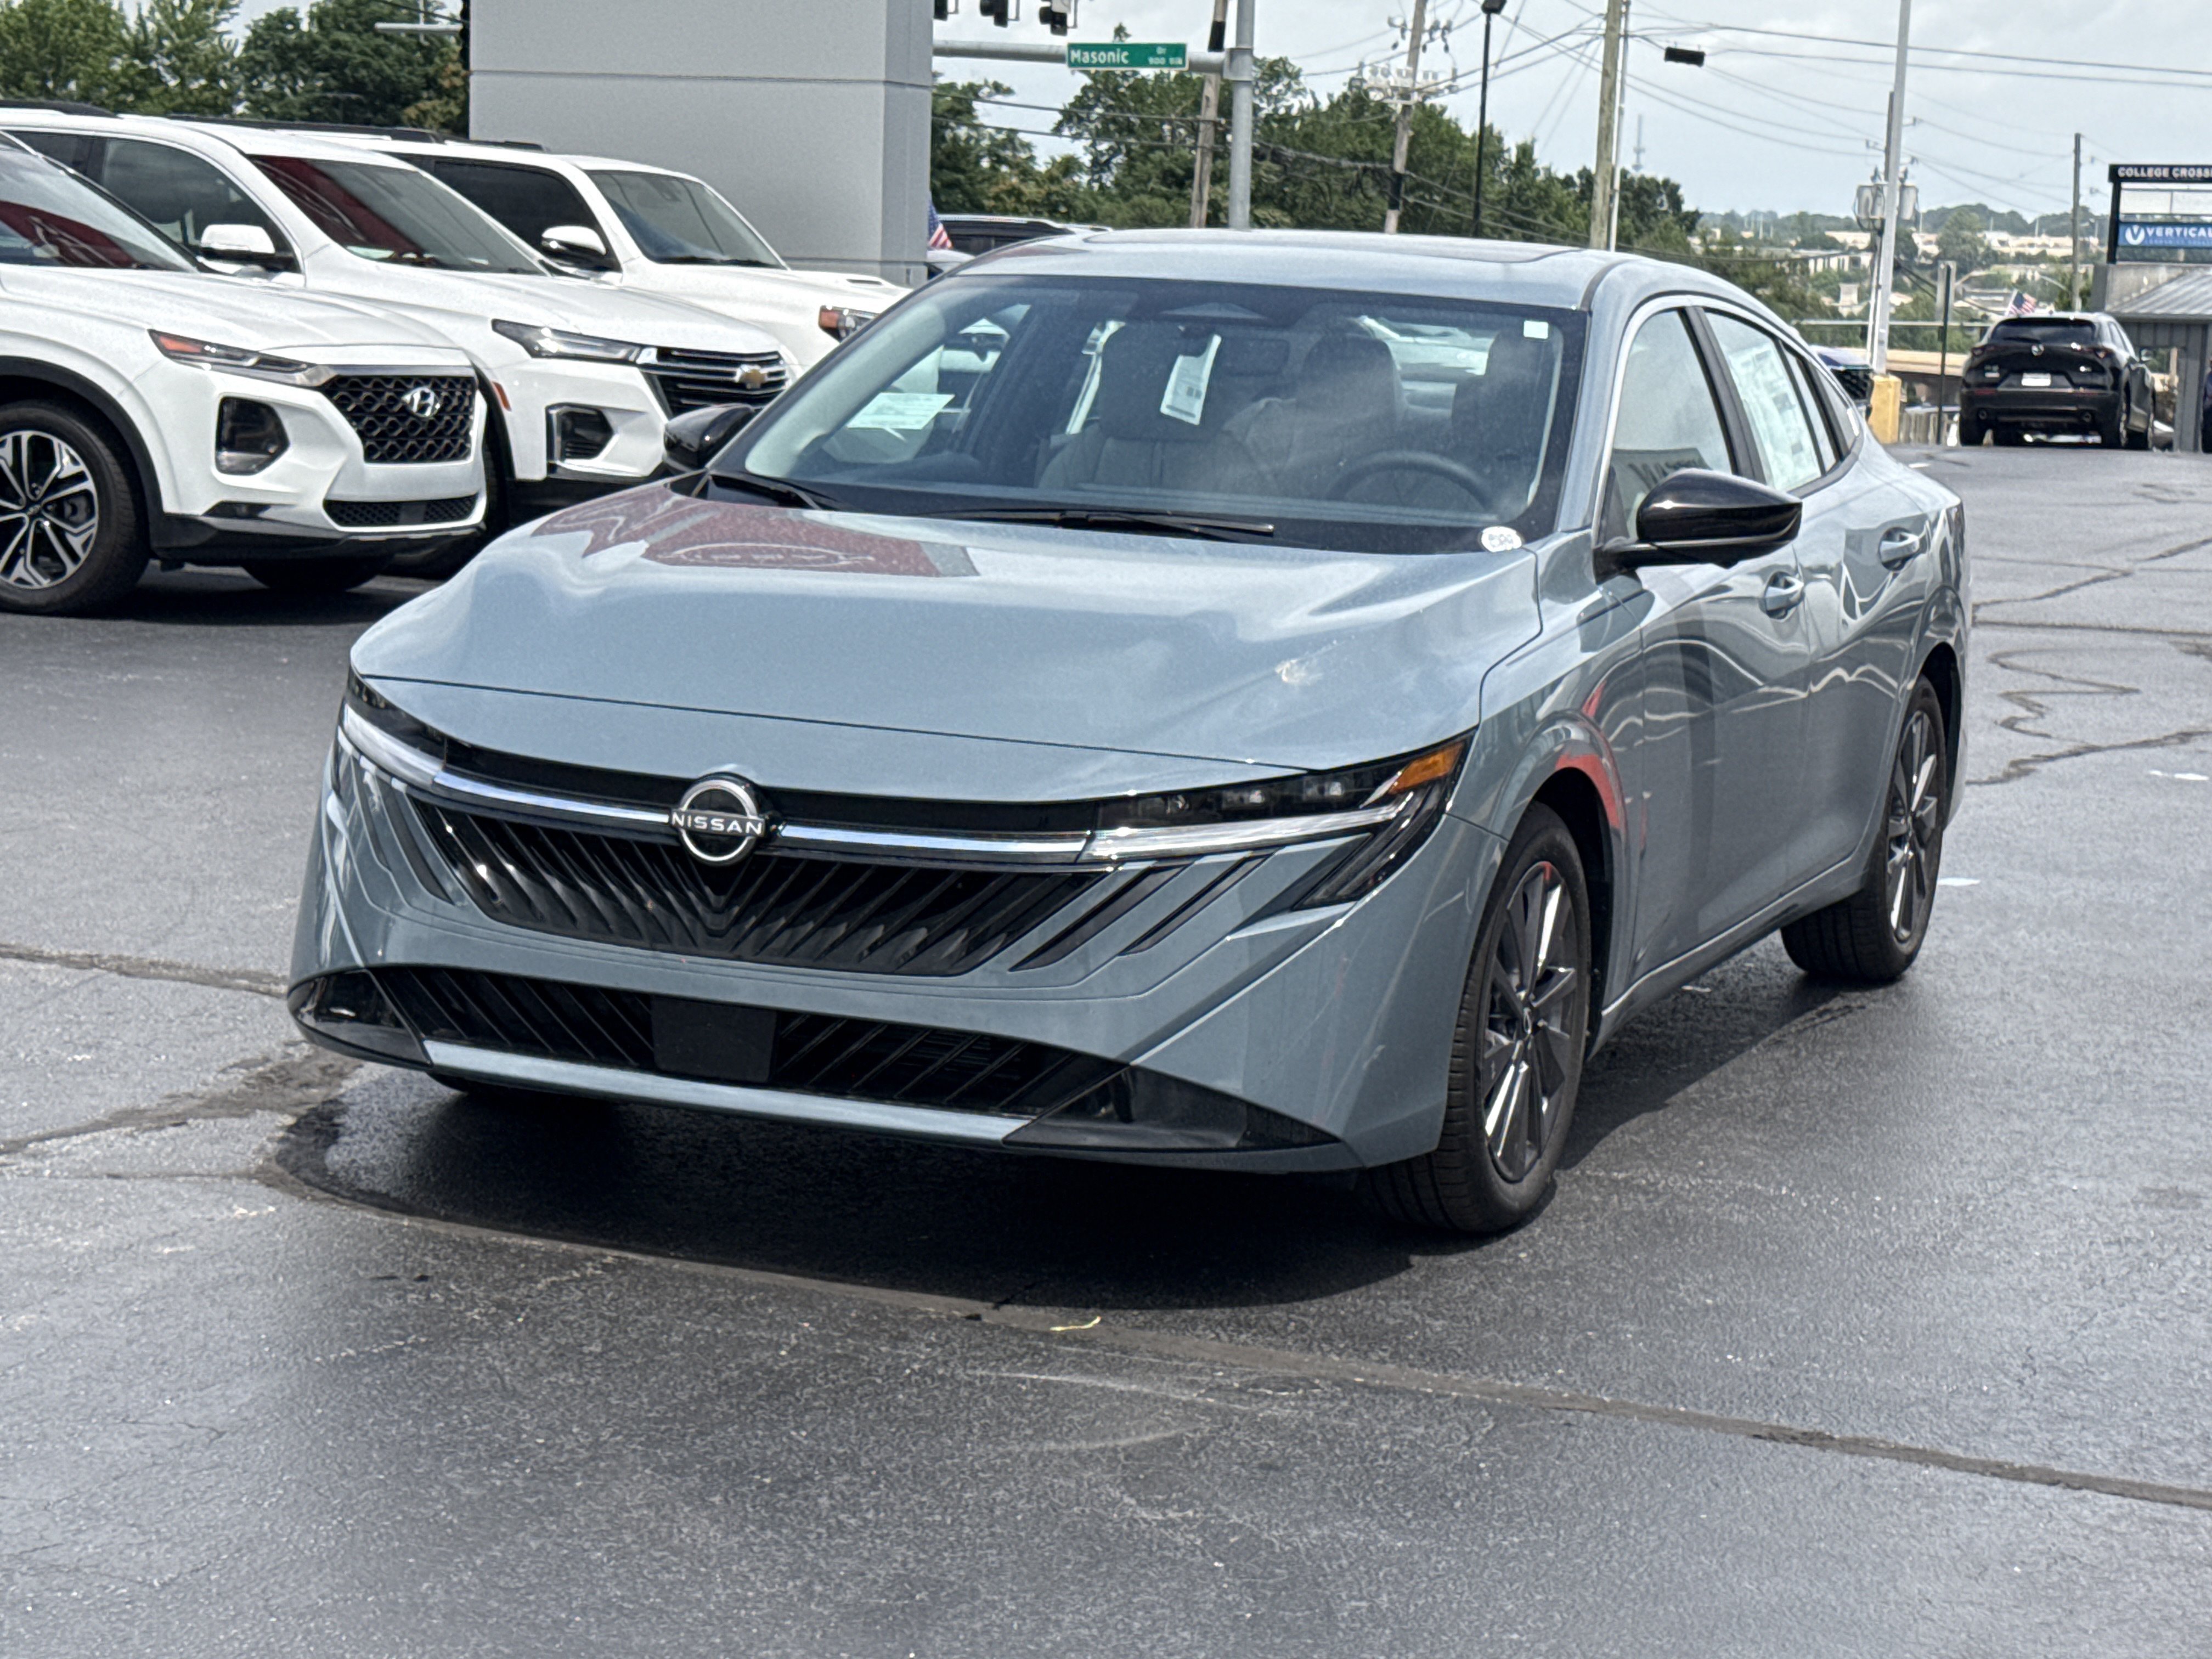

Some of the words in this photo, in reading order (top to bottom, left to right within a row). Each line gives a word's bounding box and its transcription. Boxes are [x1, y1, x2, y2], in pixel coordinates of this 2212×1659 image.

[1070, 48, 1130, 64] Masonic
[2117, 166, 2170, 178] COLLEGE
[672, 811, 763, 835] NISSAN
